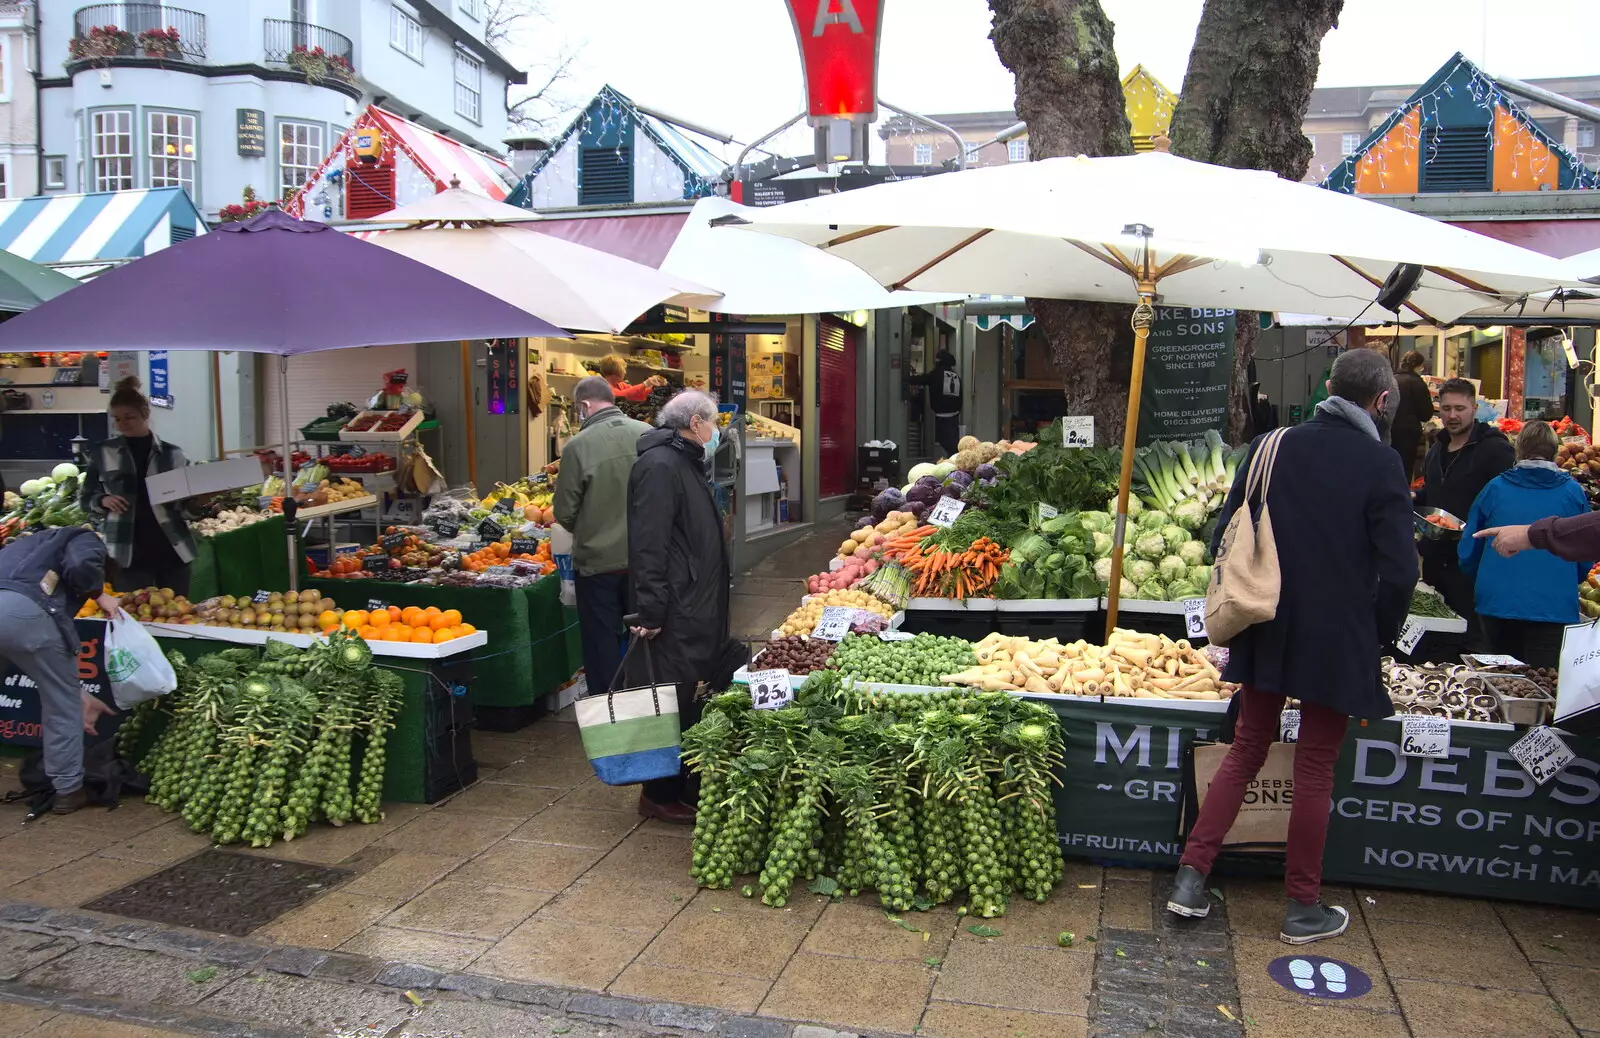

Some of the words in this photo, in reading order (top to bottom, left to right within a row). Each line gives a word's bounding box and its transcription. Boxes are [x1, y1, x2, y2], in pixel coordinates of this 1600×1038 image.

[812, 0, 864, 37] A
[1191, 307, 1235, 319] DEBS
[1152, 329, 1172, 337] AND
[1177, 321, 1224, 336] SONS
[1152, 342, 1226, 353] GREENGROCERS
[1176, 352, 1218, 361] NORWICH
[1165, 362, 1194, 370] SINCE
[1197, 361, 1216, 369] 1968
[1155, 387, 1194, 395] NORWICH
[1195, 384, 1228, 393] MARKET
[5, 674, 18, 686] of
[18, 675, 38, 689] Nor
[1093, 721, 1210, 769] MI
[1351, 738, 1600, 805] DEBS
[1124, 779, 1182, 802] GR
[1250, 779, 1293, 789] DEBS
[1456, 808, 1513, 832] OF
[1364, 847, 1538, 881] NORWICH
